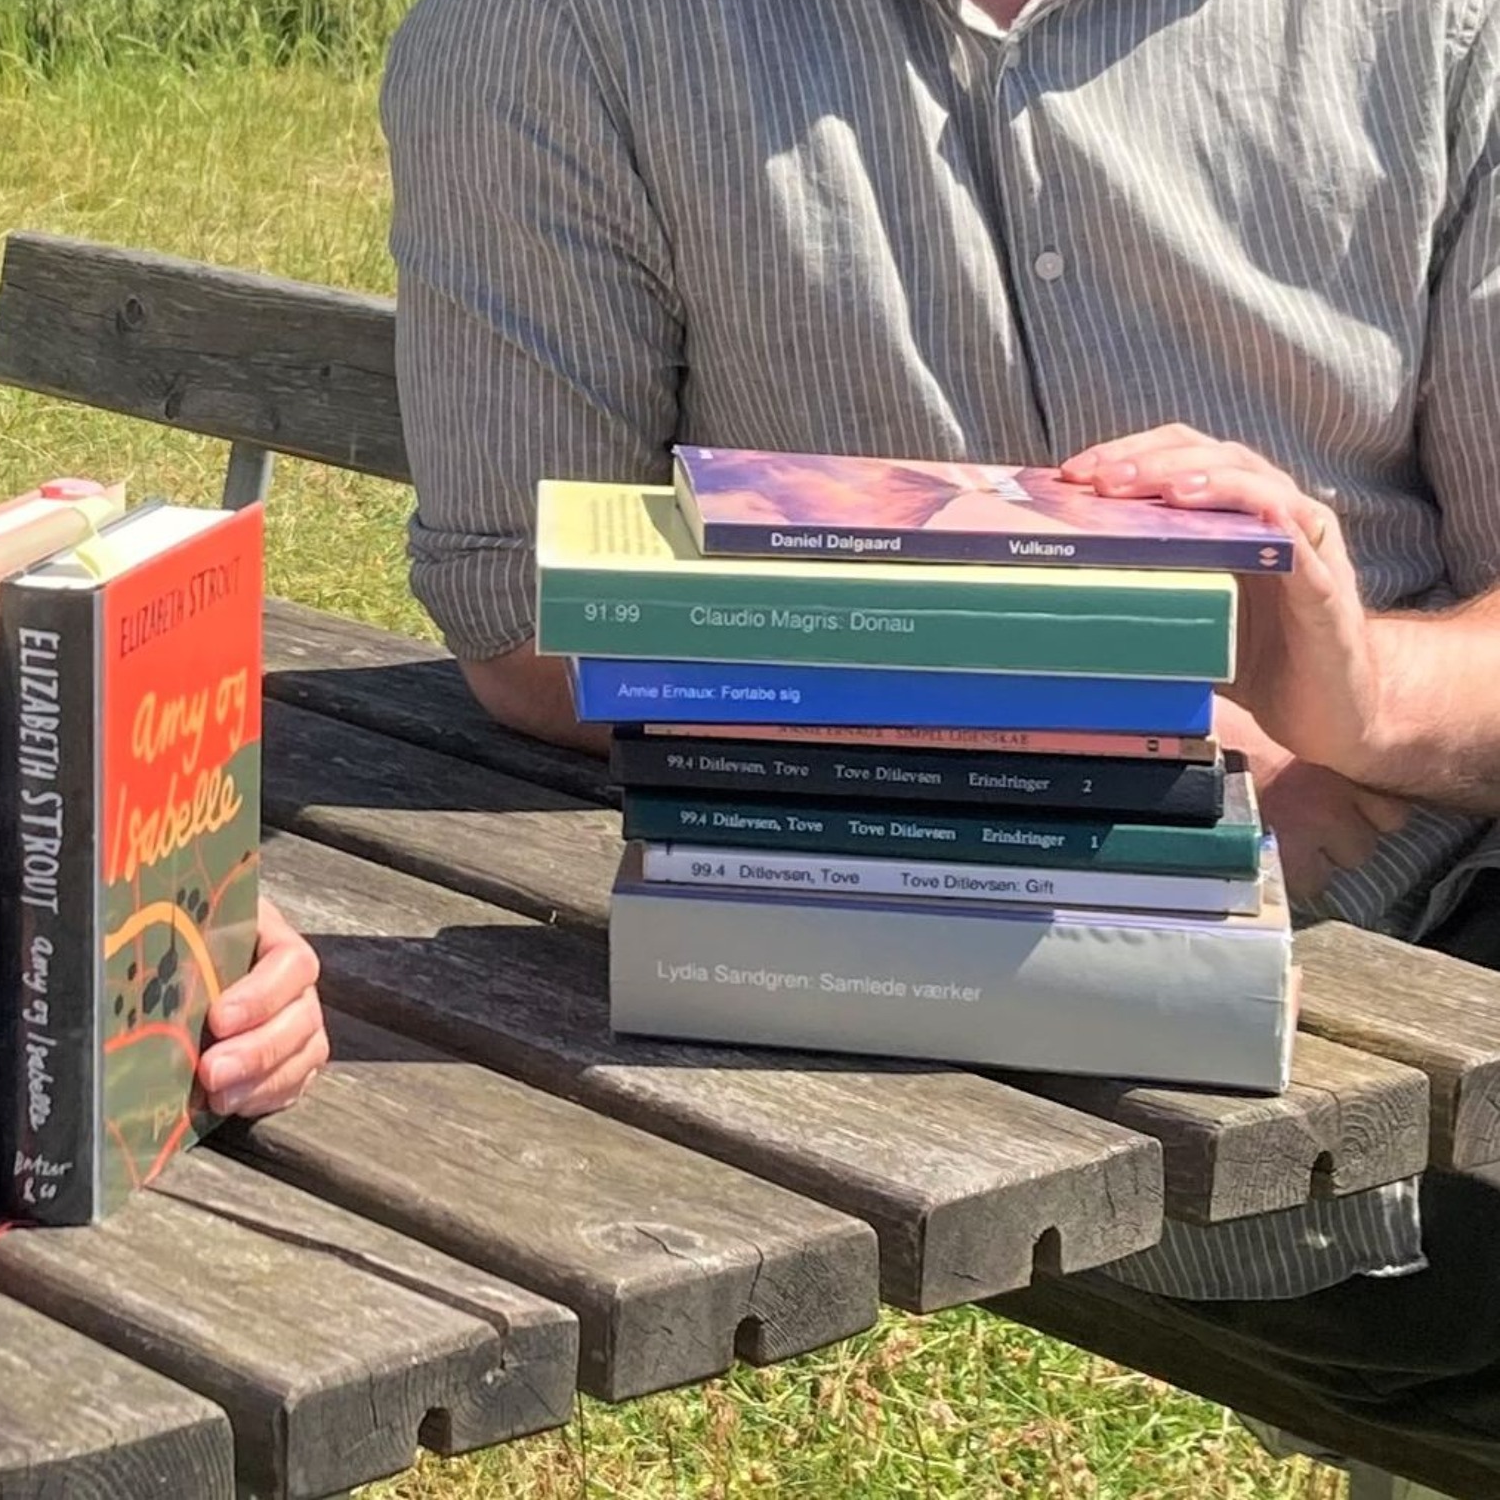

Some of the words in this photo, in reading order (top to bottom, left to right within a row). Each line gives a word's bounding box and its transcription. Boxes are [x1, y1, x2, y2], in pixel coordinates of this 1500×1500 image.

[771, 532, 823, 548] Daniel
[827, 534, 901, 553] Dalgaard
[1008, 539, 1076, 557] Vulkano
[120, 588, 184, 659] ELIZABETH
[189, 556, 241, 618] STROUT
[584, 604, 640, 622] 91.99
[690, 607, 766, 628] Claudio
[771, 610, 844, 634] Magris:
[850, 612, 915, 633] Donau
[19, 628, 62, 780] ELIZABETH
[216, 667, 248, 752] og
[618, 683, 658, 699] Annie
[721, 685, 776, 701] Fortabe
[779, 686, 801, 704] sig
[667, 754, 693, 770] 99.4
[699, 755, 767, 775] Ditlevsen,
[773, 761, 810, 777] Tove
[834, 764, 870, 780] Tove
[875, 767, 942, 784] Ditlevsen
[968, 772, 1050, 793] Erindringer
[1082, 780, 1092, 793] 2
[108, 765, 244, 887] Isabelle
[680, 811, 707, 825] 99.4
[712, 813, 781, 831] Ditlevsen,
[787, 816, 824, 832] Tove
[848, 820, 885, 836] Tove
[890, 822, 957, 841] Ditlevsen
[982, 828, 1065, 848] Erindringer
[1090, 835, 1099, 849] 1
[21, 790, 63, 915] STROUT
[691, 862, 726, 877] 99.4
[739, 864, 815, 884] Ditlevsen,
[821, 868, 860, 885] Tove
[901, 872, 939, 889] Tove
[944, 875, 1020, 893] Ditlevsen:
[1025, 879, 1054, 894] Gift
[657, 961, 709, 985] Lydia
[714, 964, 809, 992] Sandgren:
[819, 972, 907, 998] Samlede
[912, 982, 983, 1002] værker
[21, 1000, 50, 1026] og
[26, 1032, 58, 1133] Isabelle
